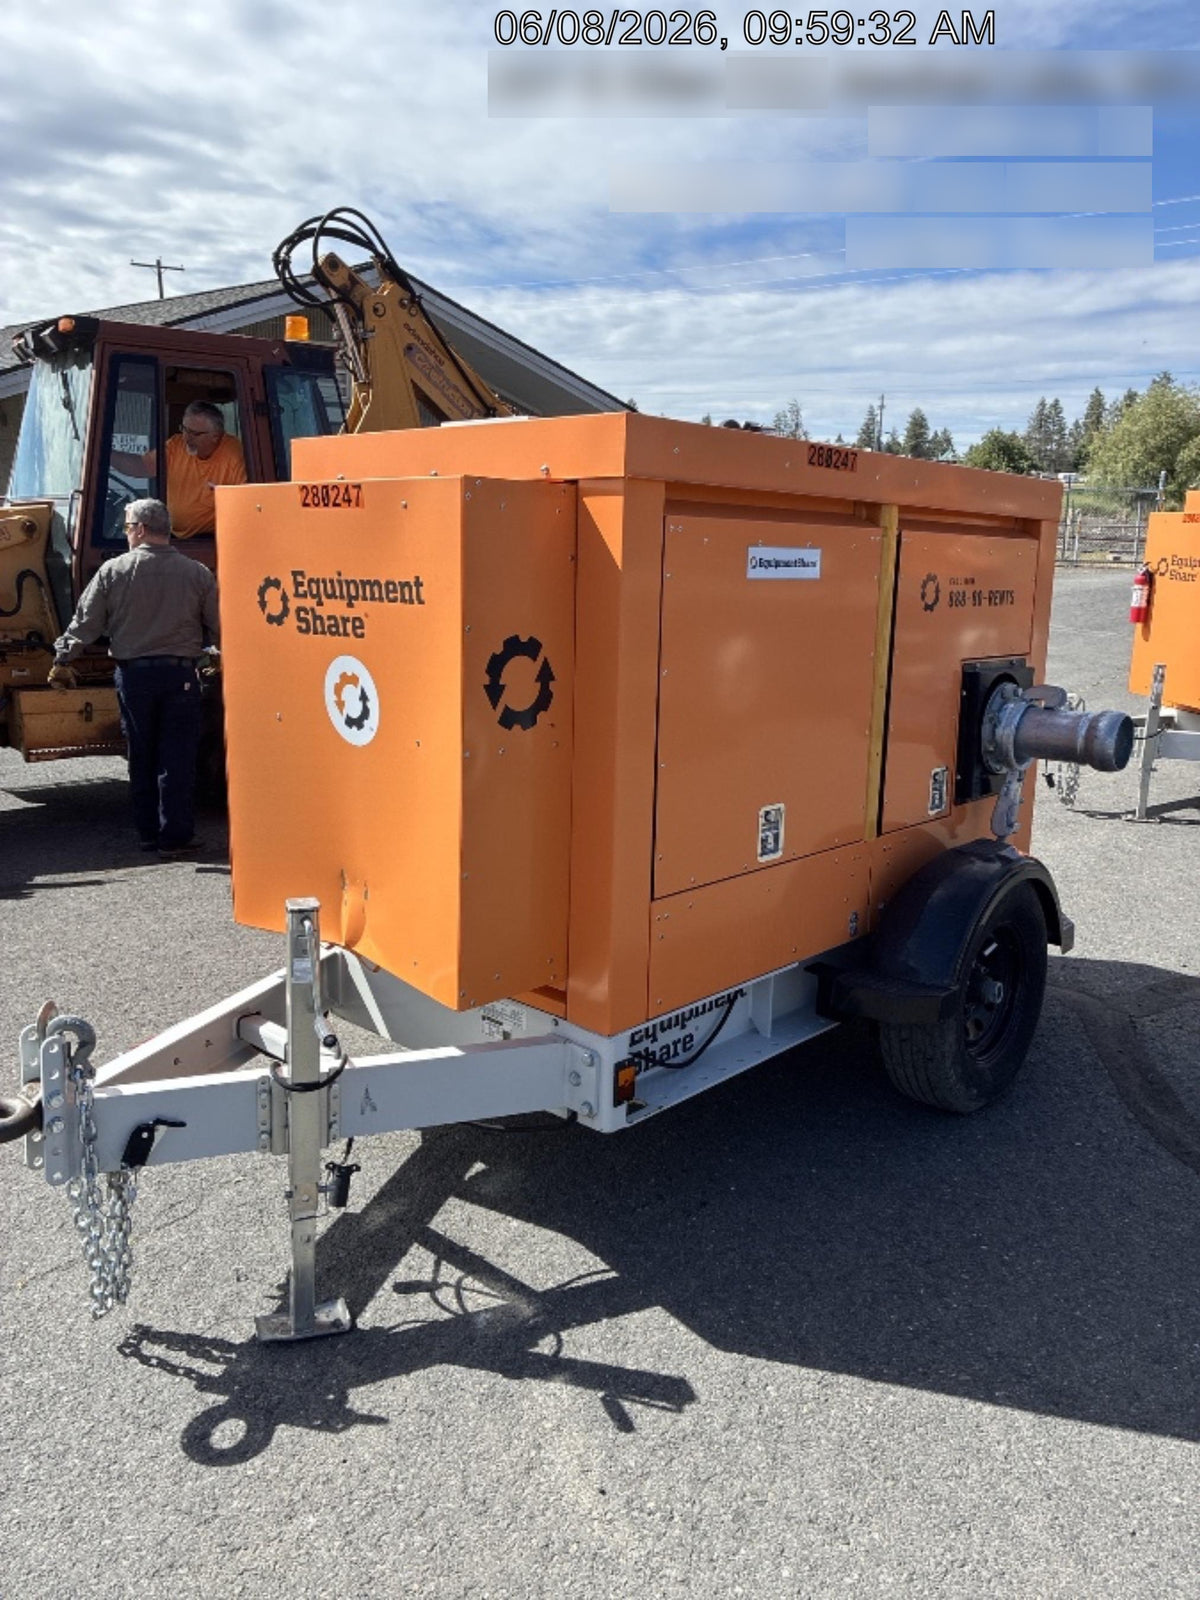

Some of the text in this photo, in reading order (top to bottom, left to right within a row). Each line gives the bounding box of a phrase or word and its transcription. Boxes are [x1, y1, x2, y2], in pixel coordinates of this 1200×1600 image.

[807, 444, 858, 472] 280247
[300, 483, 362, 507] 280247
[291, 570, 425, 608] Equipment
[294, 605, 366, 639] Share
